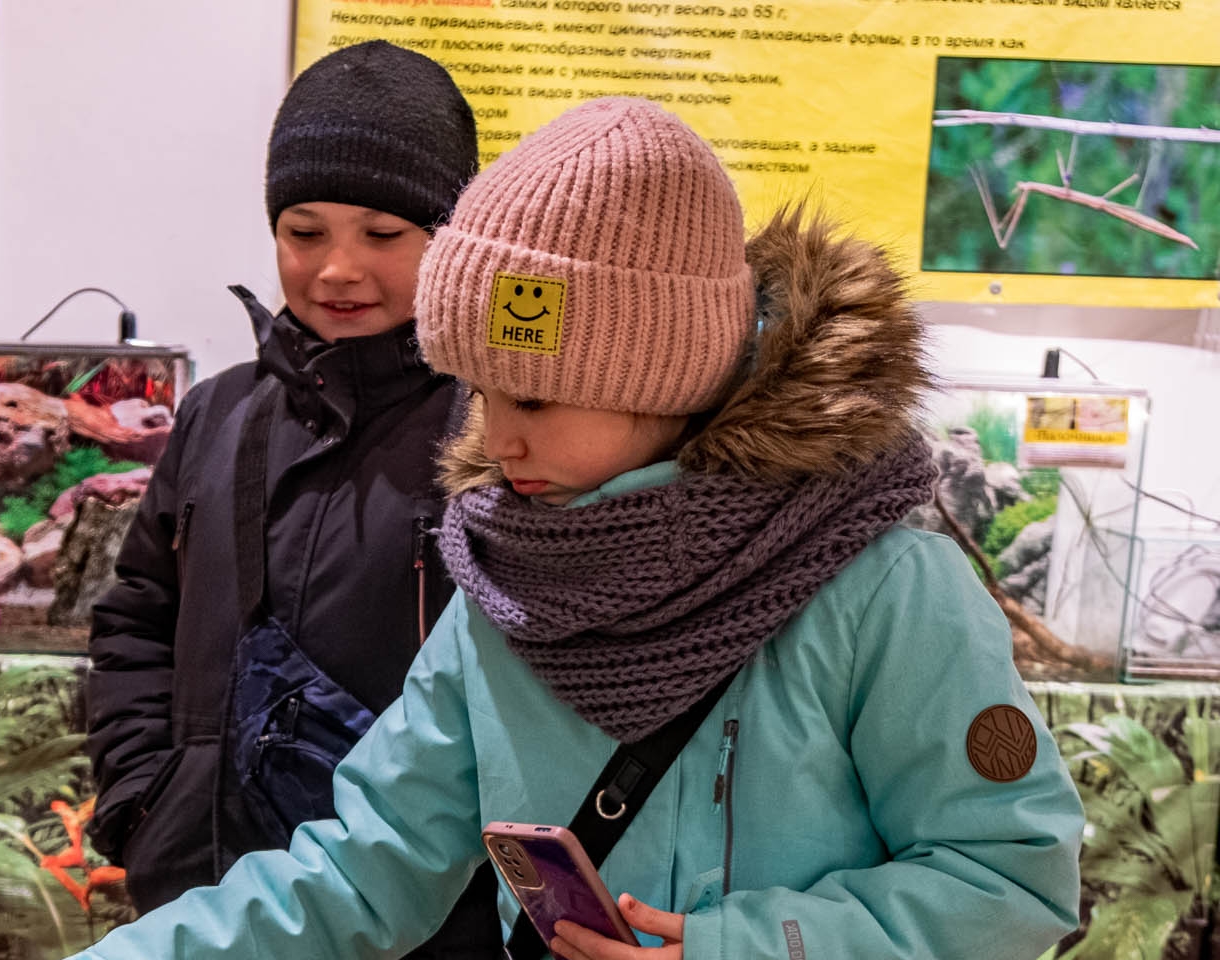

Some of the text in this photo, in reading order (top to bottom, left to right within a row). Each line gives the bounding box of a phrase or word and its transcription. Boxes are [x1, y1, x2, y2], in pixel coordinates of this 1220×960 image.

[554, 0, 621, 13] которого
[627, 3, 669, 17] могут
[674, 5, 724, 18] весить
[729, 7, 748, 19] до
[331, 10, 415, 26] Некоторые
[554, 22, 605, 34] имеют
[609, 24, 738, 38] цилиндрические
[741, 29, 843, 43] палковидные
[925, 35, 941, 47] то
[945, 36, 995, 48] время
[999, 38, 1026, 49] как
[441, 39, 503, 51] плоские
[631, 47, 712, 60] очертания
[528, 66, 554, 76] или
[571, 66, 696, 82] уменьшенными
[528, 87, 573, 98] видов
[679, 92, 732, 104] короче
[824, 142, 877, 154] задние
[502, 325, 544, 344] HERE
